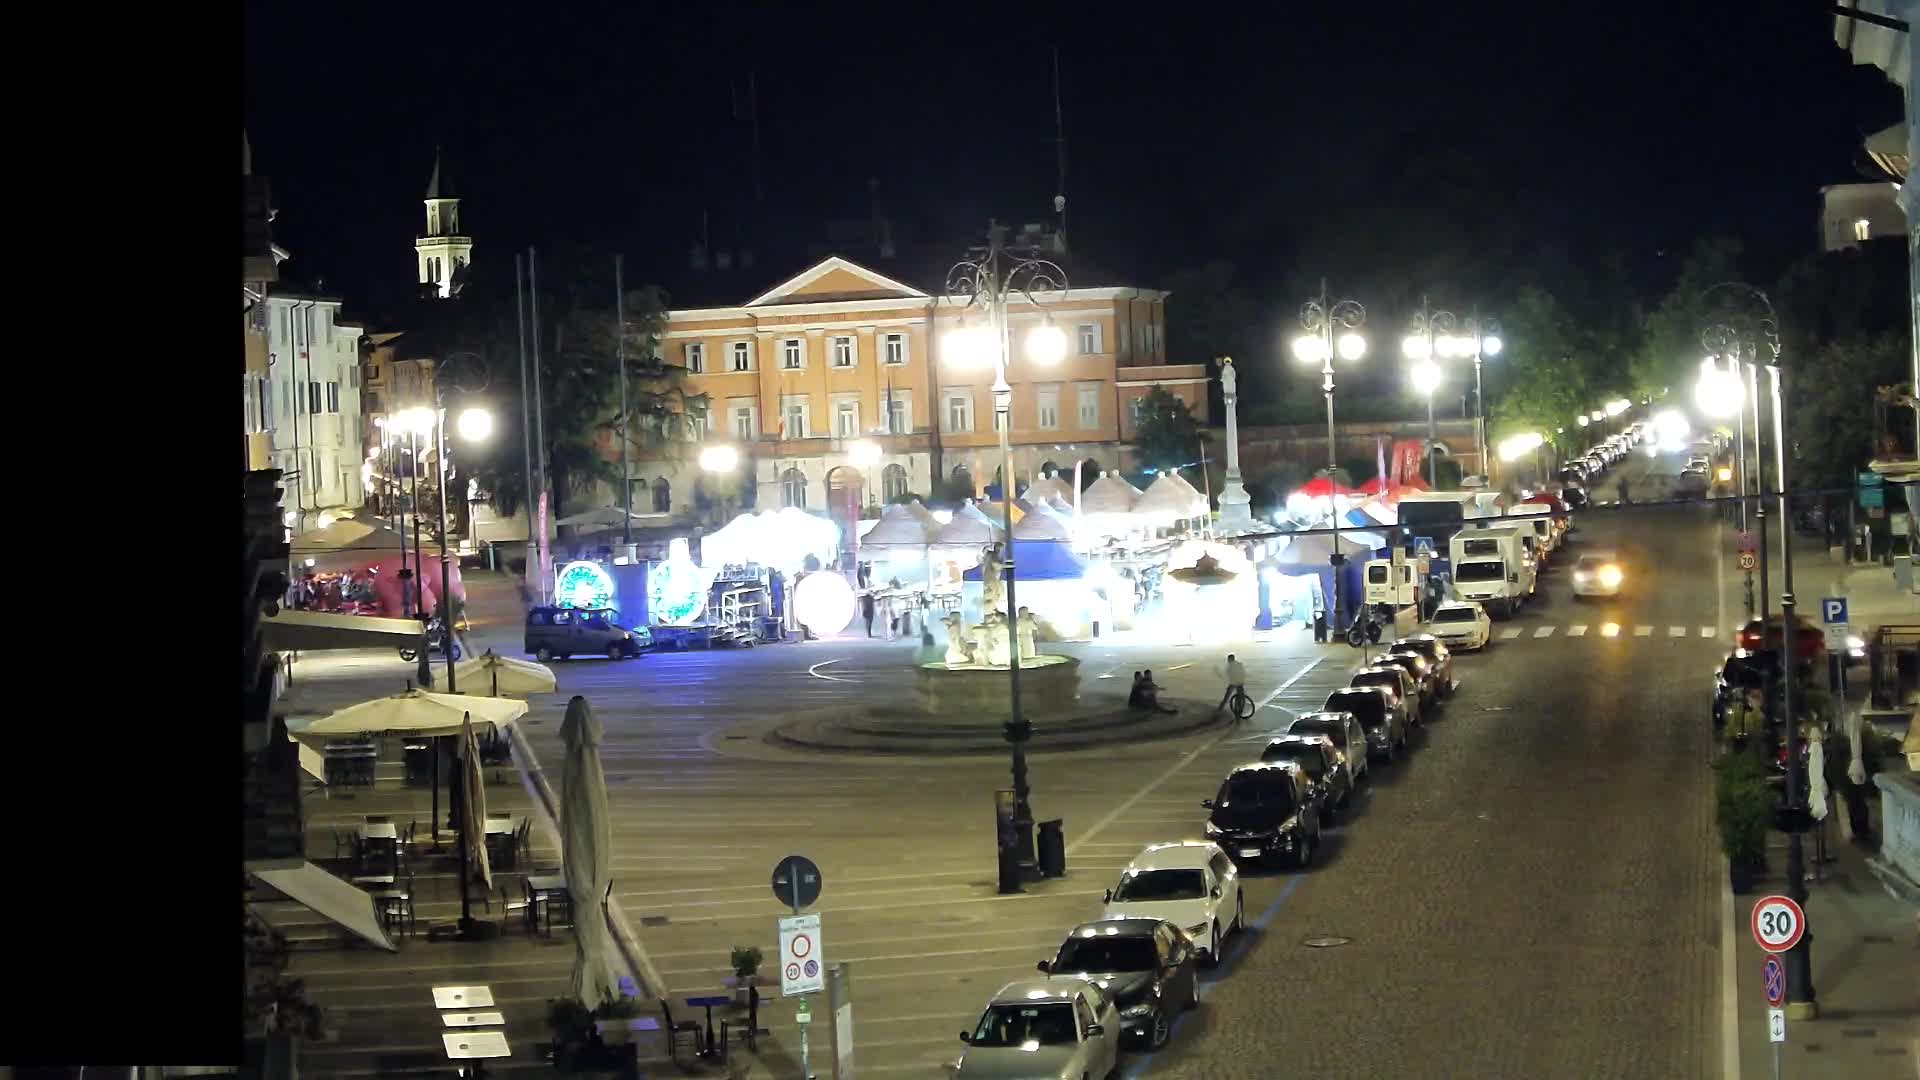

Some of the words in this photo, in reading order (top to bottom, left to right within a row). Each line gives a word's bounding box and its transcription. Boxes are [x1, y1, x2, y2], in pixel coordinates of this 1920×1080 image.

[1828, 601, 1842, 621] P
[1763, 911, 1791, 936] 30
[789, 967, 797, 977] 20
